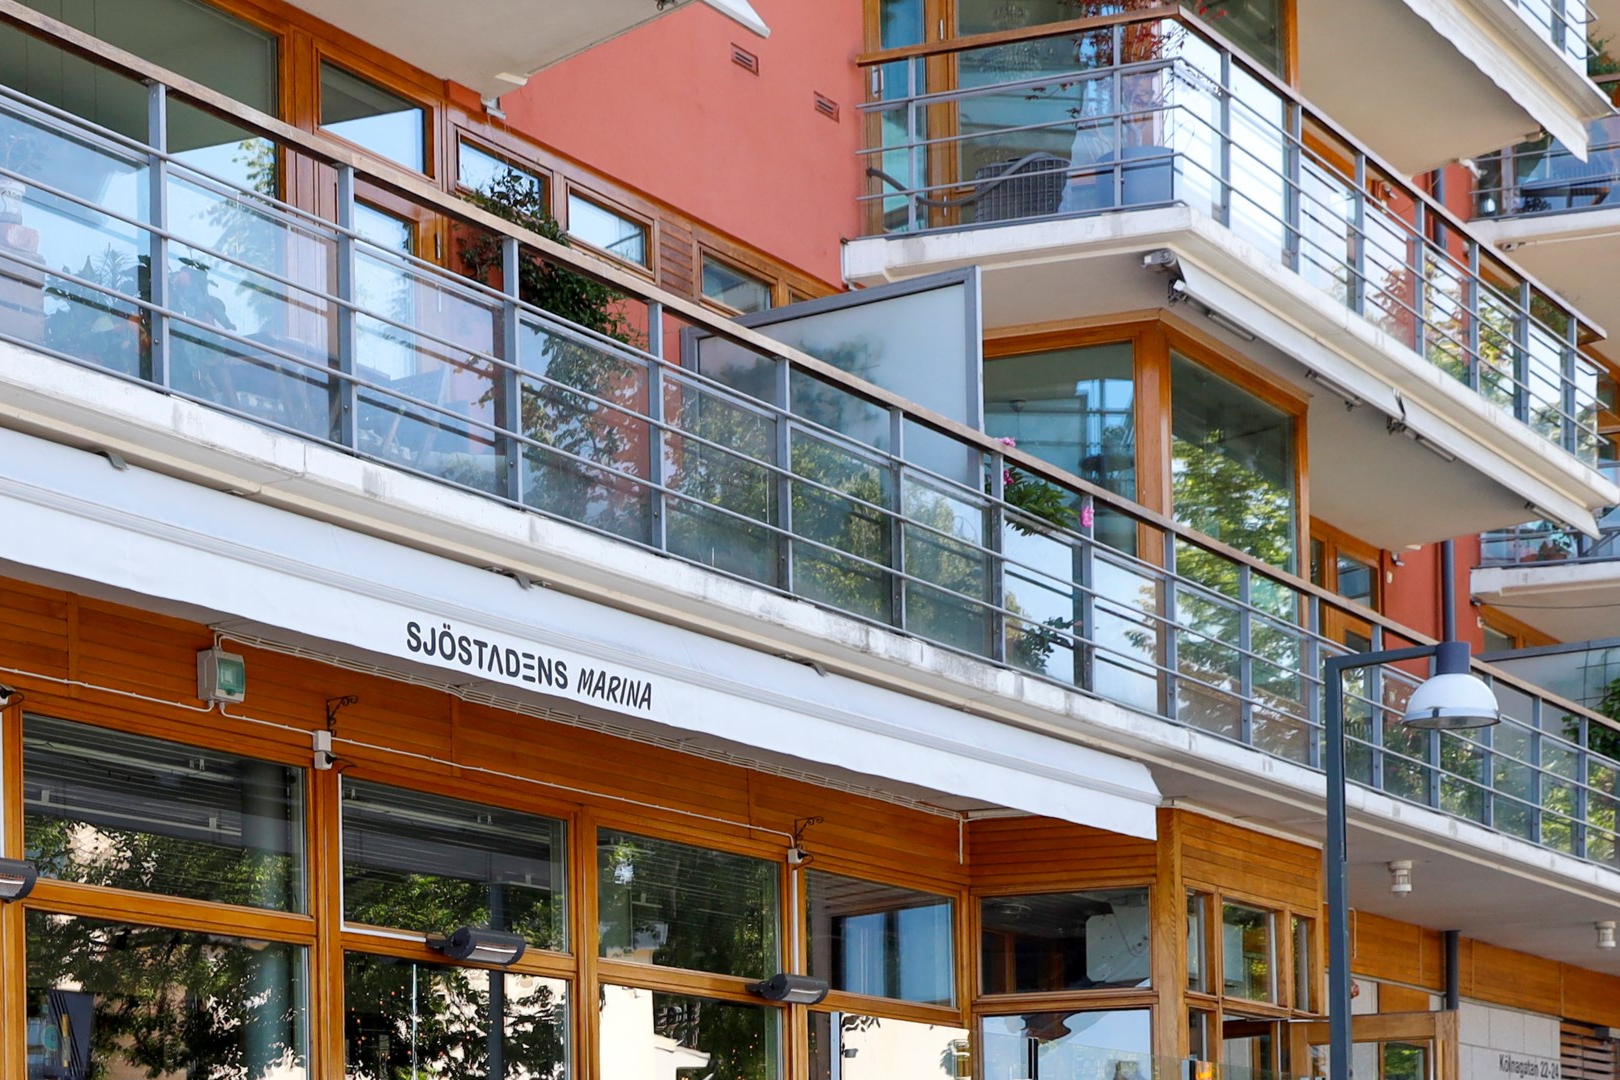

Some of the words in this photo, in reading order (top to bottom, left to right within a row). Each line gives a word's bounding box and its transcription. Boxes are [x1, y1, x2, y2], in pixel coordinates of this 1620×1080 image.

[406, 621, 569, 690] SJÖSTADENS
[577, 667, 652, 711] MARINA
[1499, 1053, 1539, 1079] Kölnagatan
